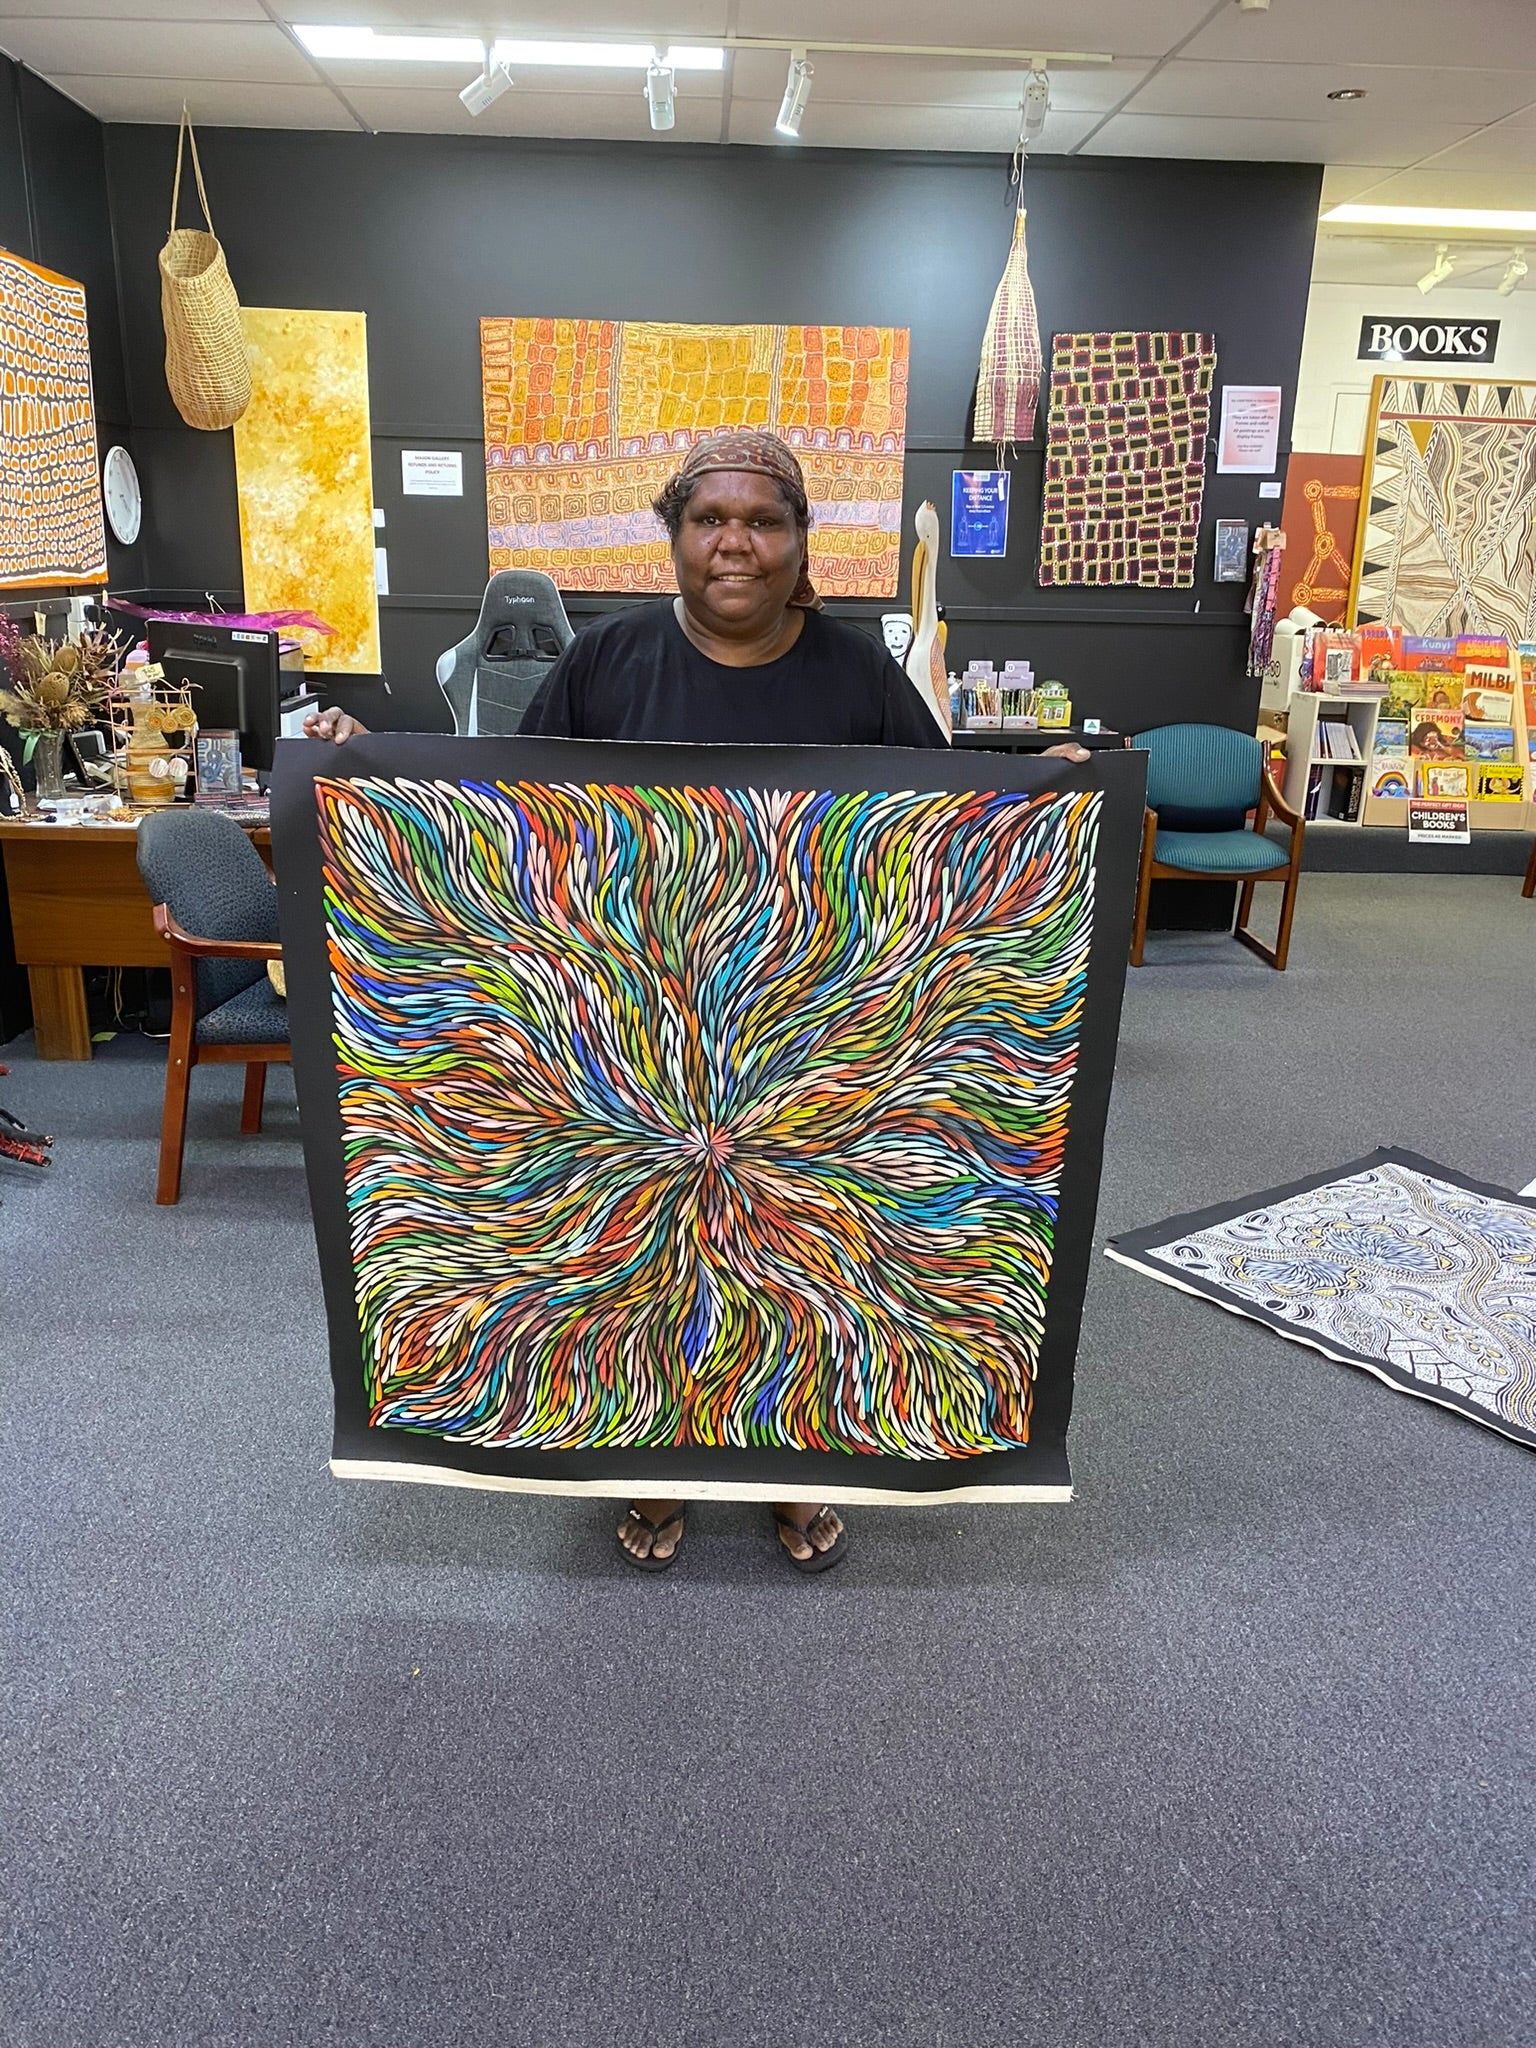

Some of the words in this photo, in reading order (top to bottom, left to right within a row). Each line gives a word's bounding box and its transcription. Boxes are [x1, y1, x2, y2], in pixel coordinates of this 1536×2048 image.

[1368, 324, 1488, 355] BOOKS
[504, 595, 535, 604] Typhoon
[1470, 671, 1511, 690] MILBI
[1415, 714, 1464, 724] CEREMONY
[1411, 811, 1466, 822] CHILDREN'S
[1423, 820, 1456, 829] BOOKS
